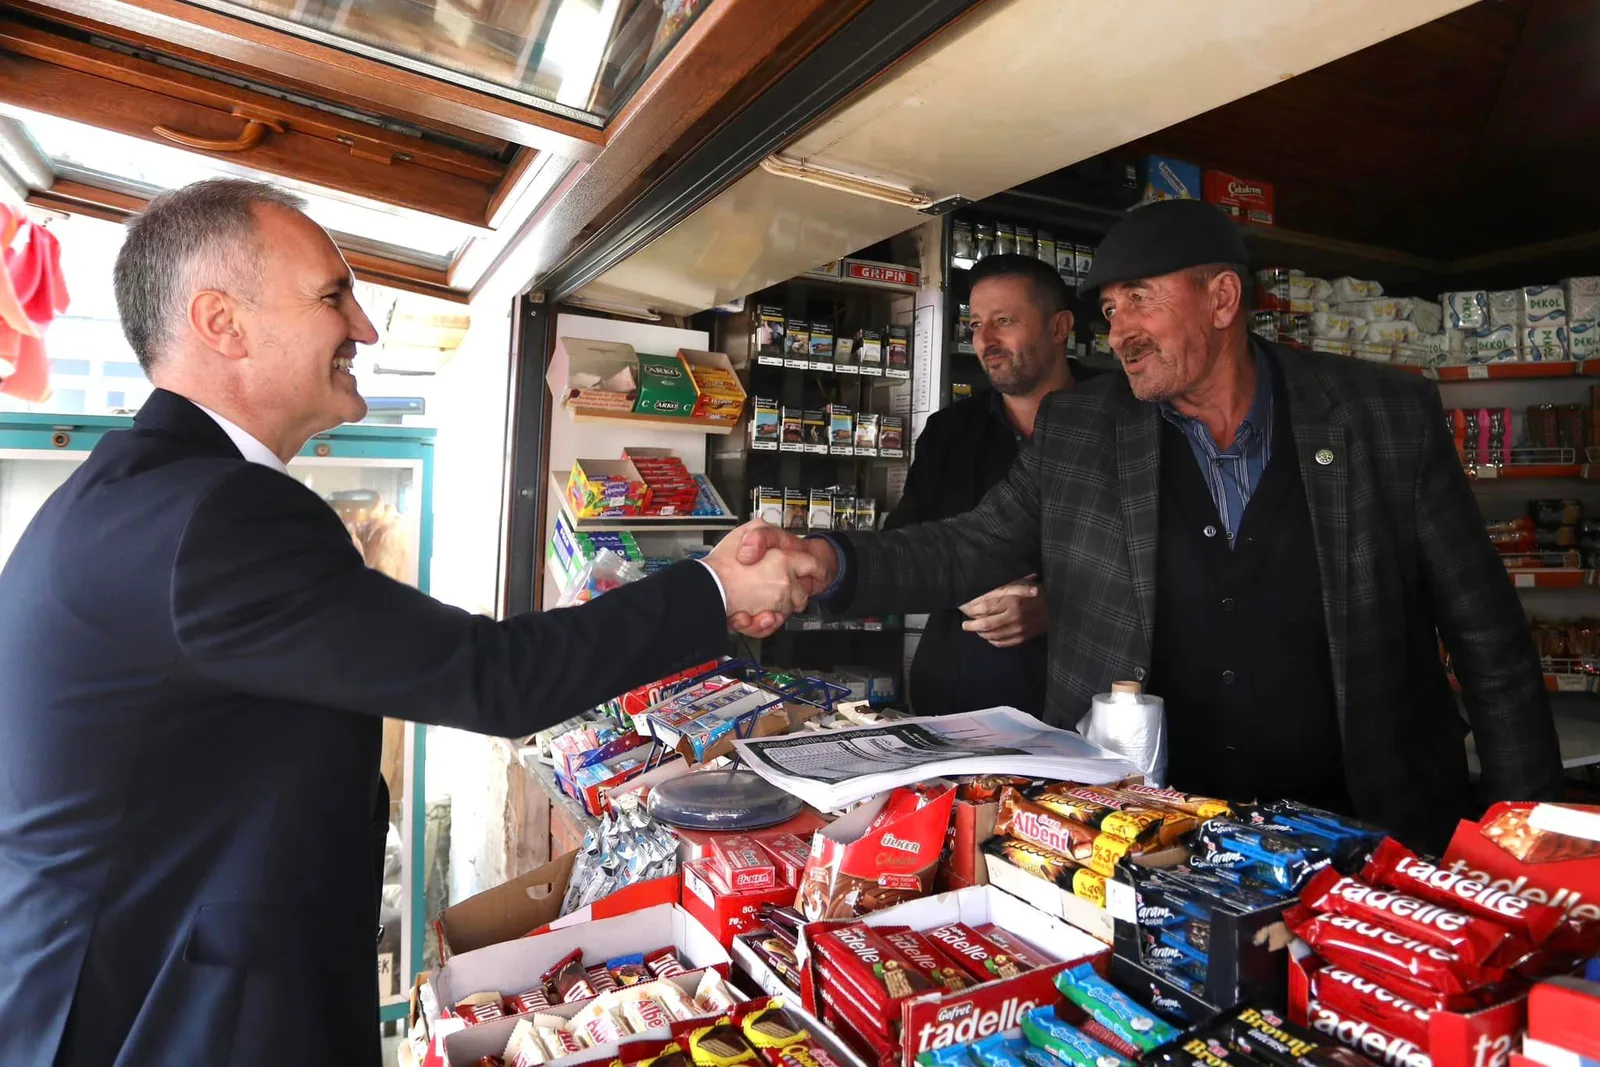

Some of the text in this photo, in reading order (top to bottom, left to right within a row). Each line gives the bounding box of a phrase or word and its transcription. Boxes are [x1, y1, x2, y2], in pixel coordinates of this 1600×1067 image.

[1530, 299, 1561, 309] DEKOL
[1479, 340, 1508, 350] DEKOL
[649, 367, 678, 377] ARKO
[656, 402, 678, 410] ARKO
[880, 833, 920, 854] ÜLKER
[1013, 810, 1069, 852] Albeni
[1395, 856, 1530, 919] tadelle
[1329, 876, 1468, 933] tadelle
[832, 927, 880, 964] adelle
[638, 999, 667, 1029] Albe
[938, 1003, 973, 1023] Gofret
[1237, 1008, 1319, 1057] Browni
[1308, 999, 1432, 1067] tadelle
